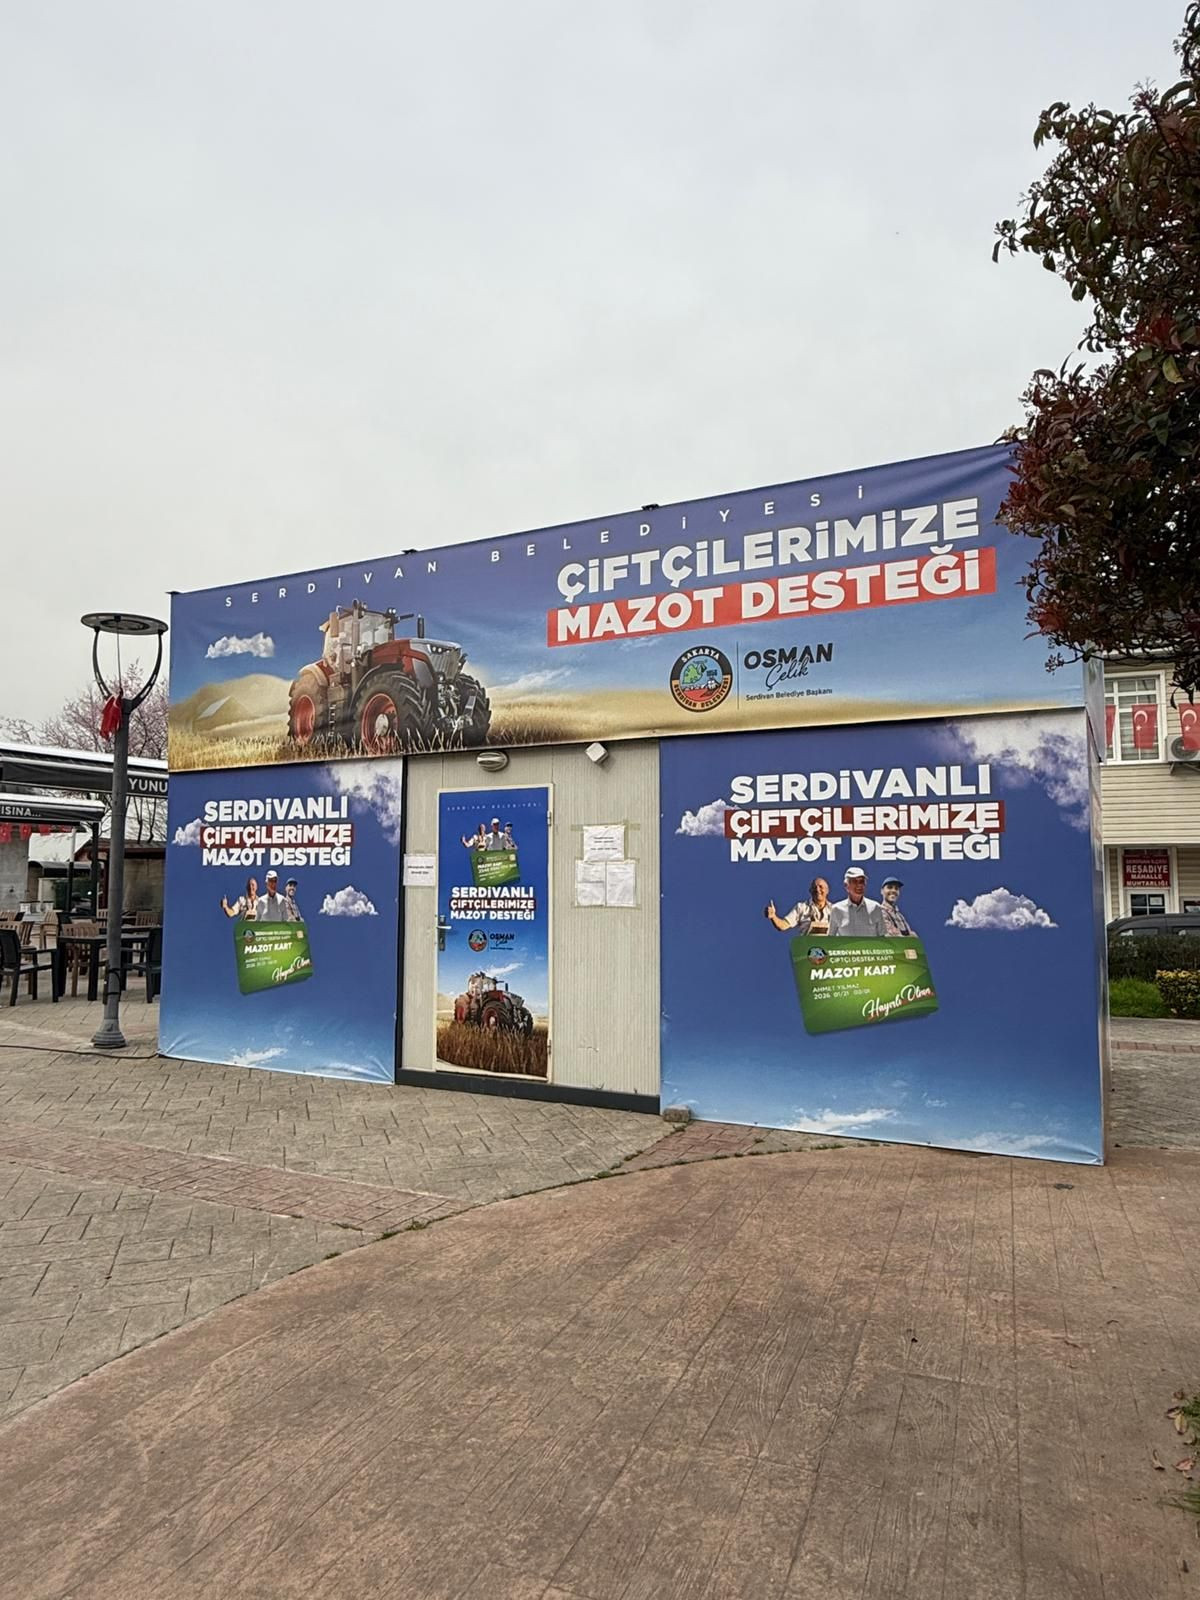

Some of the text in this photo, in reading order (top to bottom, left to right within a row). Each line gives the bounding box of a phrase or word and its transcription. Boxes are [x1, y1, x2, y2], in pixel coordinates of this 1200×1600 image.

[556, 586, 725, 642] MAZOT
[681, 648, 720, 662] SAKARYA
[744, 643, 833, 692] OSMAN Çelik
[745, 687, 833, 701] Serdivan Belediye Başkanı
[202, 847, 266, 866] MAZOT
[730, 837, 842, 862] MAZOT
[450, 910, 487, 920] MAZOT
[244, 941, 293, 955] MAZOT KART
[810, 964, 897, 981] MAZOT KART
